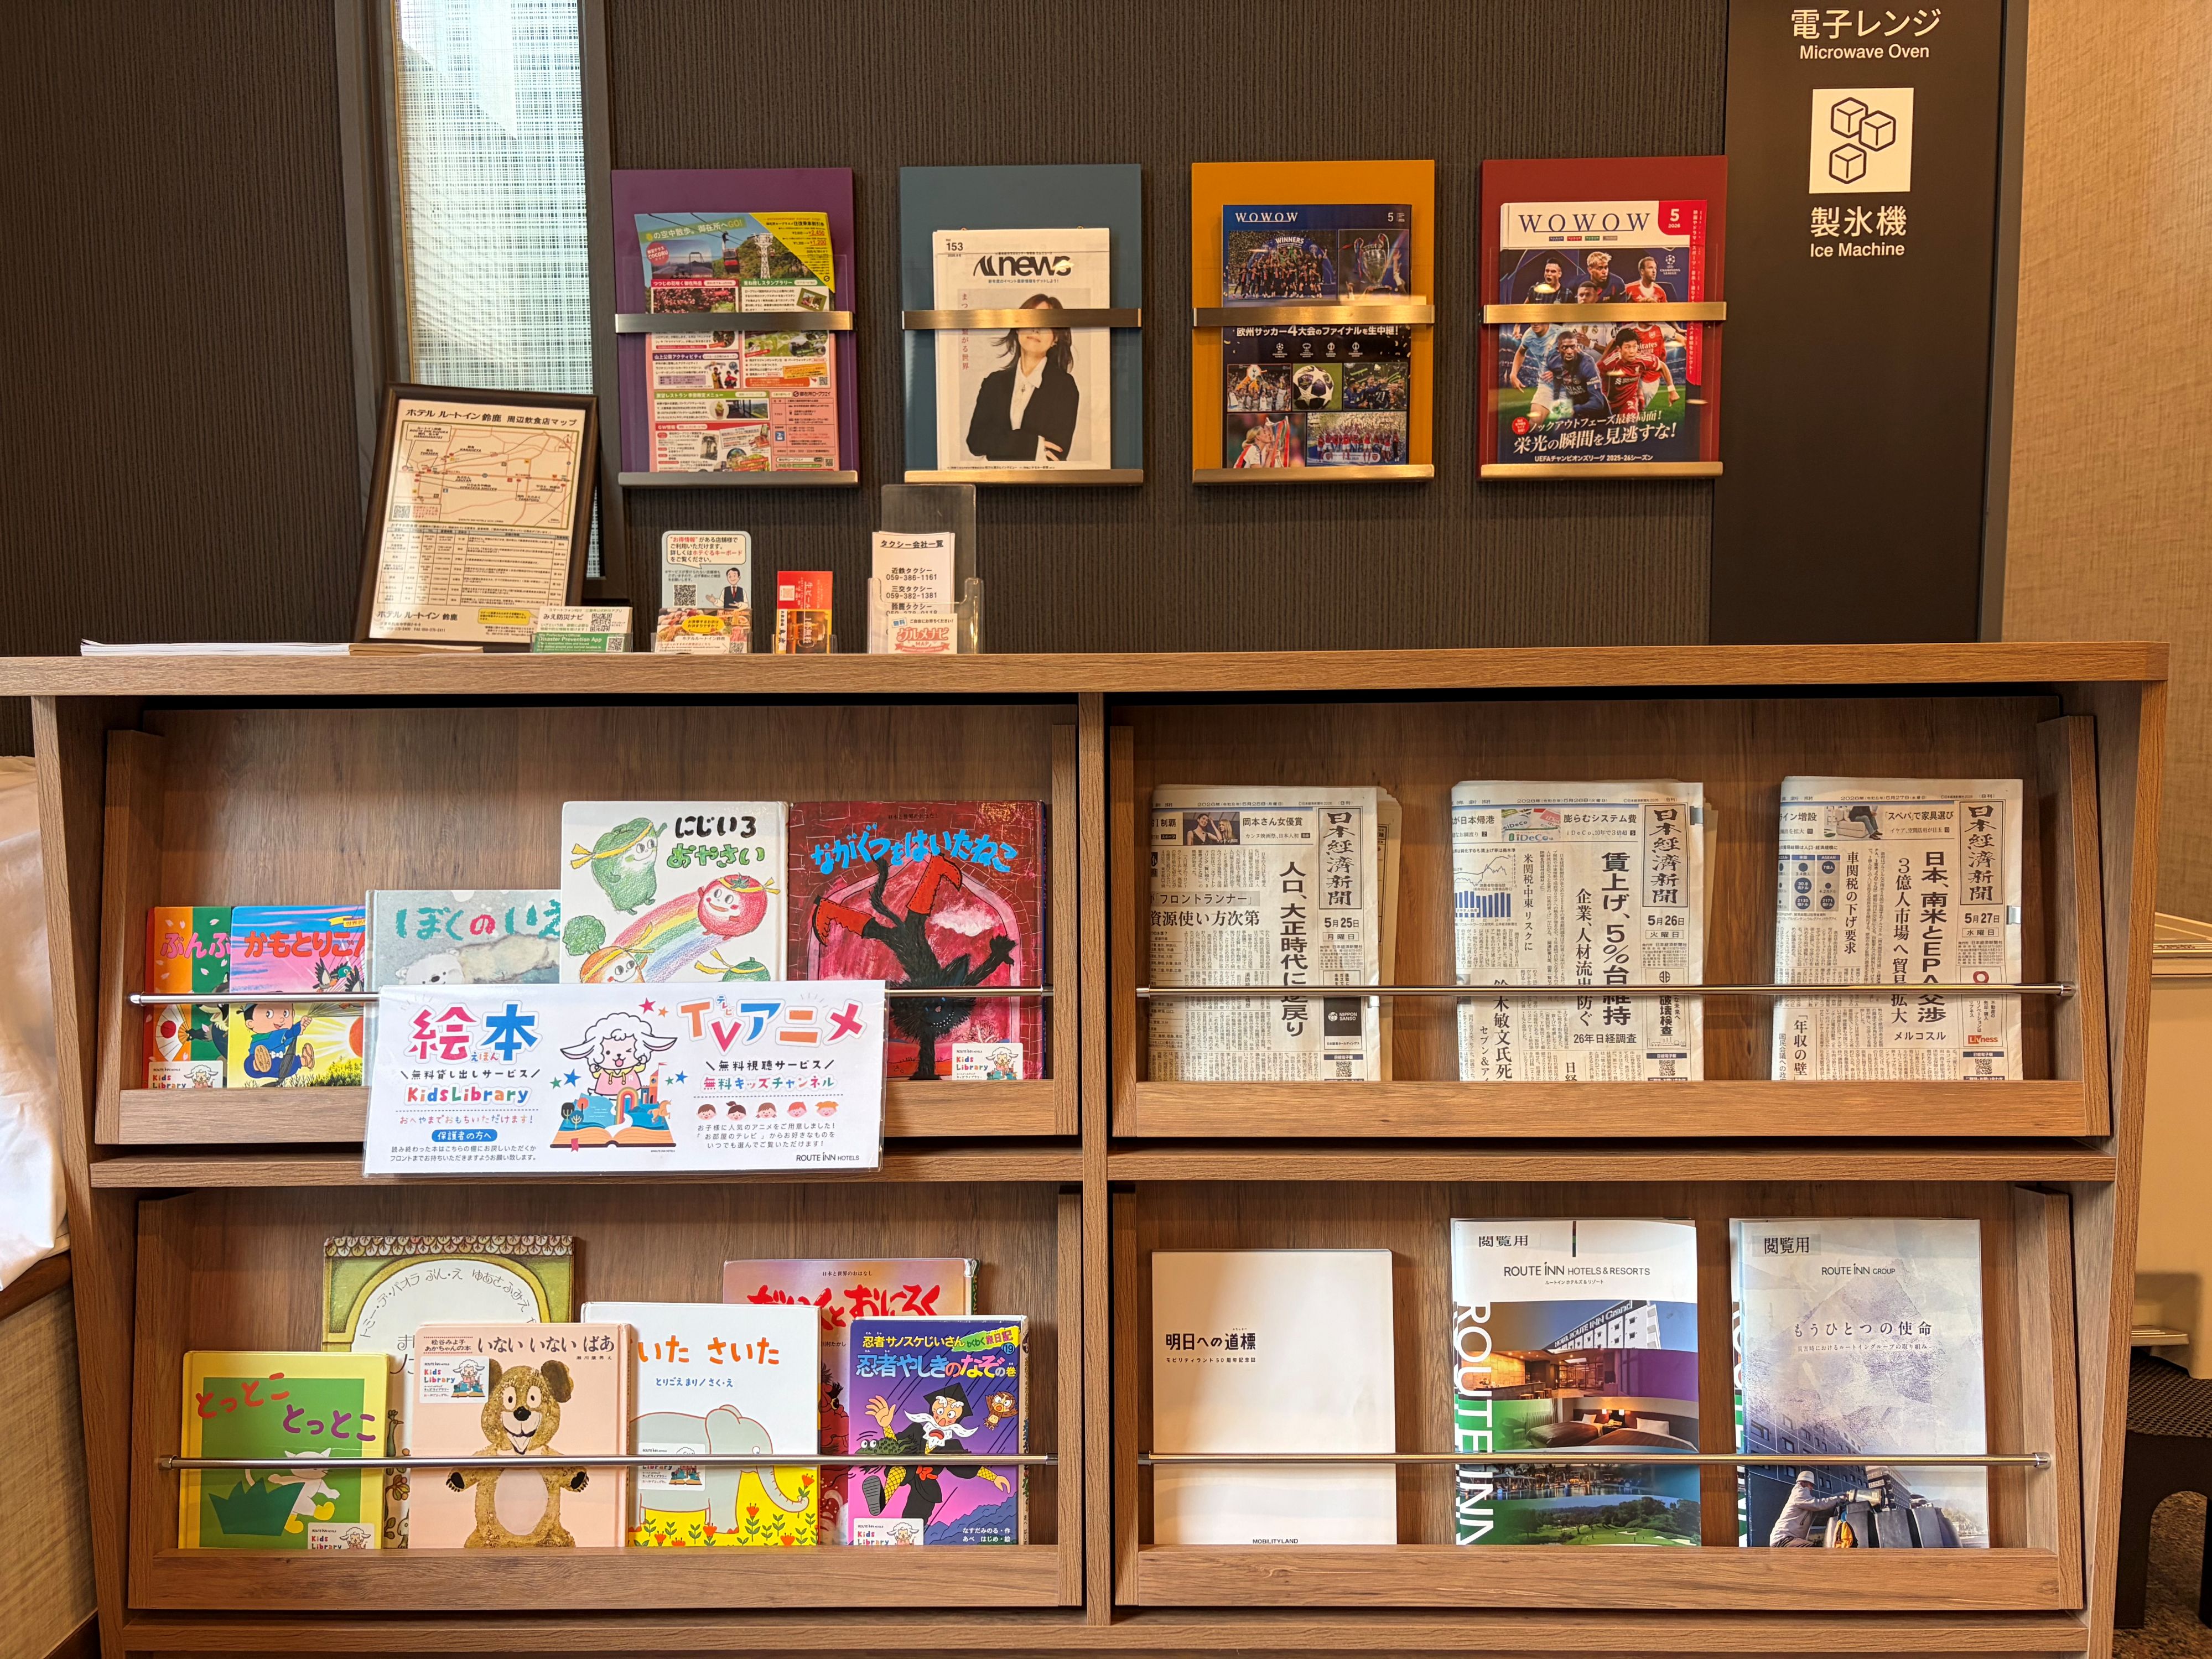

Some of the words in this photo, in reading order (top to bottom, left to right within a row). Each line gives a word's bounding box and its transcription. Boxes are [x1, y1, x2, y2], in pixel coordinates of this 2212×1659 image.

[1791, 8, 1941, 39] 電子レンジ
[1800, 45, 1883, 59] Microwave
[1888, 44, 1929, 58] Oven
[1235, 212, 1298, 222] WOWOW
[1388, 212, 1394, 222] 5
[1518, 213, 1650, 233] WOWOW
[1670, 209, 1679, 221] 5
[1810, 206, 1907, 237] 製氷機
[946, 242, 963, 251] 153
[1275, 236, 1305, 245] WINNERS
[1810, 243, 1833, 257] Ice
[1839, 242, 1905, 256] Machine
[1236, 325, 1398, 337] 欧州サッカー4大会のファイナルを生中継!
[406, 409, 435, 418] ホテル
[440, 410, 480, 420] ルートイン
[482, 413, 501, 423] 鈴鹿
[507, 415, 578, 426] 周辺飲食店マップ
[1529, 410, 1661, 434] ノックアウトフェーズ最終局面!
[1513, 423, 1676, 454] 栄光の瞬間を見逃すな!
[897, 627, 949, 641] グルメナビ
[1243, 817, 1303, 826] 岡本さん女優賞
[1564, 814, 1637, 824] 膨らむシステム費
[1885, 810, 1953, 820] 「スペパ」で家具選び
[675, 815, 757, 838] にじいろ
[667, 844, 765, 868] おやさい
[811, 824, 1018, 874] ながぐつをはいたねこ
[1844, 851, 1859, 953] 車関税の下げ要求
[1325, 918, 1359, 928] 5月25日
[1648, 915, 1685, 926] 5月26日
[1965, 913, 2000, 923] 5月27日
[716, 996, 733, 1016] テレビ
[408, 1003, 538, 1061] 絵本
[1574, 1033, 1637, 1044] 26年日経調査
[1895, 1032, 1946, 1041] メルコスル
[471, 1052, 499, 1062] えほん
[719, 1060, 822, 1071] 無料視聴サービス
[412, 1069, 527, 1079] 無料貸し出しサービス
[703, 1076, 834, 1090] 無料キッズチャンネル
[408, 1086, 528, 1104] KidsLibrary
[400, 1115, 533, 1125] おへやまでおもちいただけます!
[697, 1122, 835, 1131] お子様に人気のアニメをご用意しました!
[437, 1132, 492, 1141] 保護者の方へ
[707, 1140, 824, 1149] いつでも選んでご覧いただけます!
[822, 1152, 836, 1161] INN
[1478, 1235, 1529, 1248] 閲覧用
[1764, 1237, 1809, 1254] 閲覧用
[1504, 1266, 1541, 1277] ROUTE
[1544, 1261, 1565, 1276] INN
[1609, 1267, 1650, 1275] RESORTS
[1821, 1266, 1851, 1275] ROUTE
[1853, 1263, 1870, 1275] INN
[360, 1273, 420, 1338] トミー・デ・パオラ
[425, 1268, 463, 1281] ぶん・え
[1590, 1314, 1605, 1328] INN
[1606, 1300, 1633, 1320] Grand
[1794, 1321, 1932, 1336] もうひとつの使命
[478, 1337, 523, 1353] いない
[531, 1337, 577, 1353] いない
[584, 1335, 615, 1352] ばあ
[863, 1336, 965, 1348] 忍者サノスケじいさん
[1166, 1333, 1256, 1350] 明日への道標
[708, 1336, 779, 1365] さいた
[856, 1355, 1016, 1378] 忍者やしきのなぞの巻
[656, 1377, 683, 1387] とりごえ
[709, 1377, 733, 1387] さく・え
[196, 1372, 289, 1418] とっとこ
[283, 1405, 376, 1442] とっとこ
